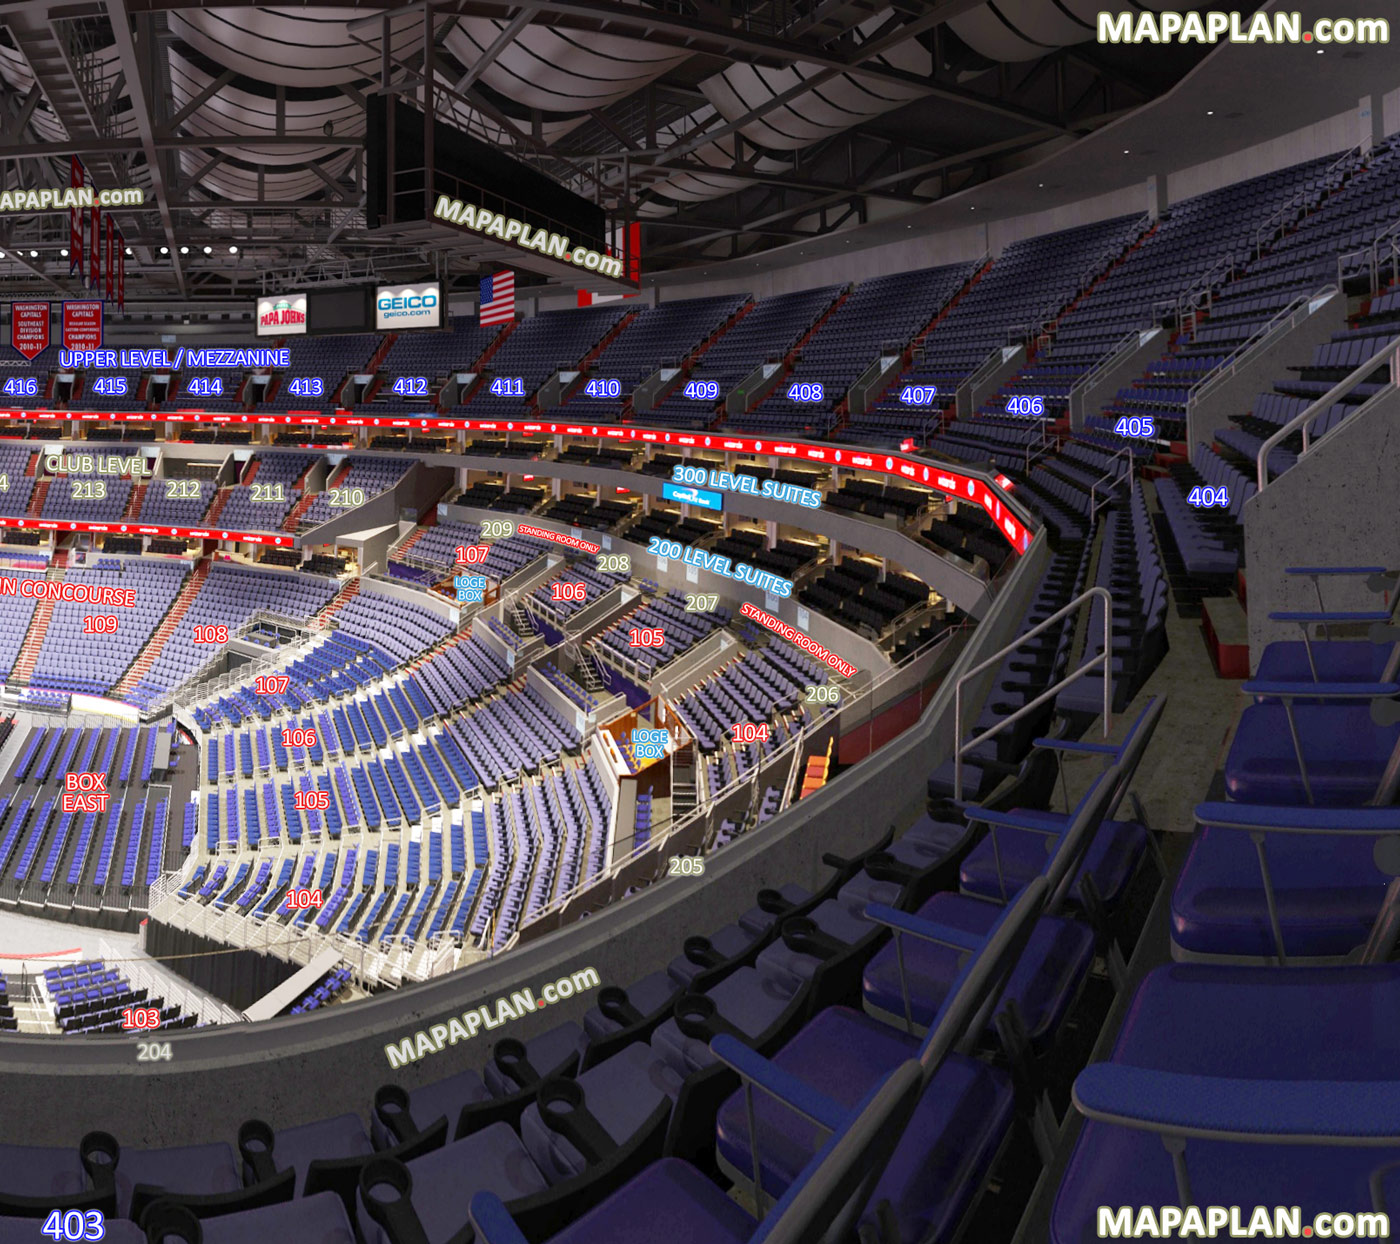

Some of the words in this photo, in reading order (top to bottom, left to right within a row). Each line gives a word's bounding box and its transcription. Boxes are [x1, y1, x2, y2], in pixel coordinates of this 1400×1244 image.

[378, 295, 437, 311] GEICO
[260, 310, 279, 326] PAPA
[383, 310, 430, 318] geico.com
